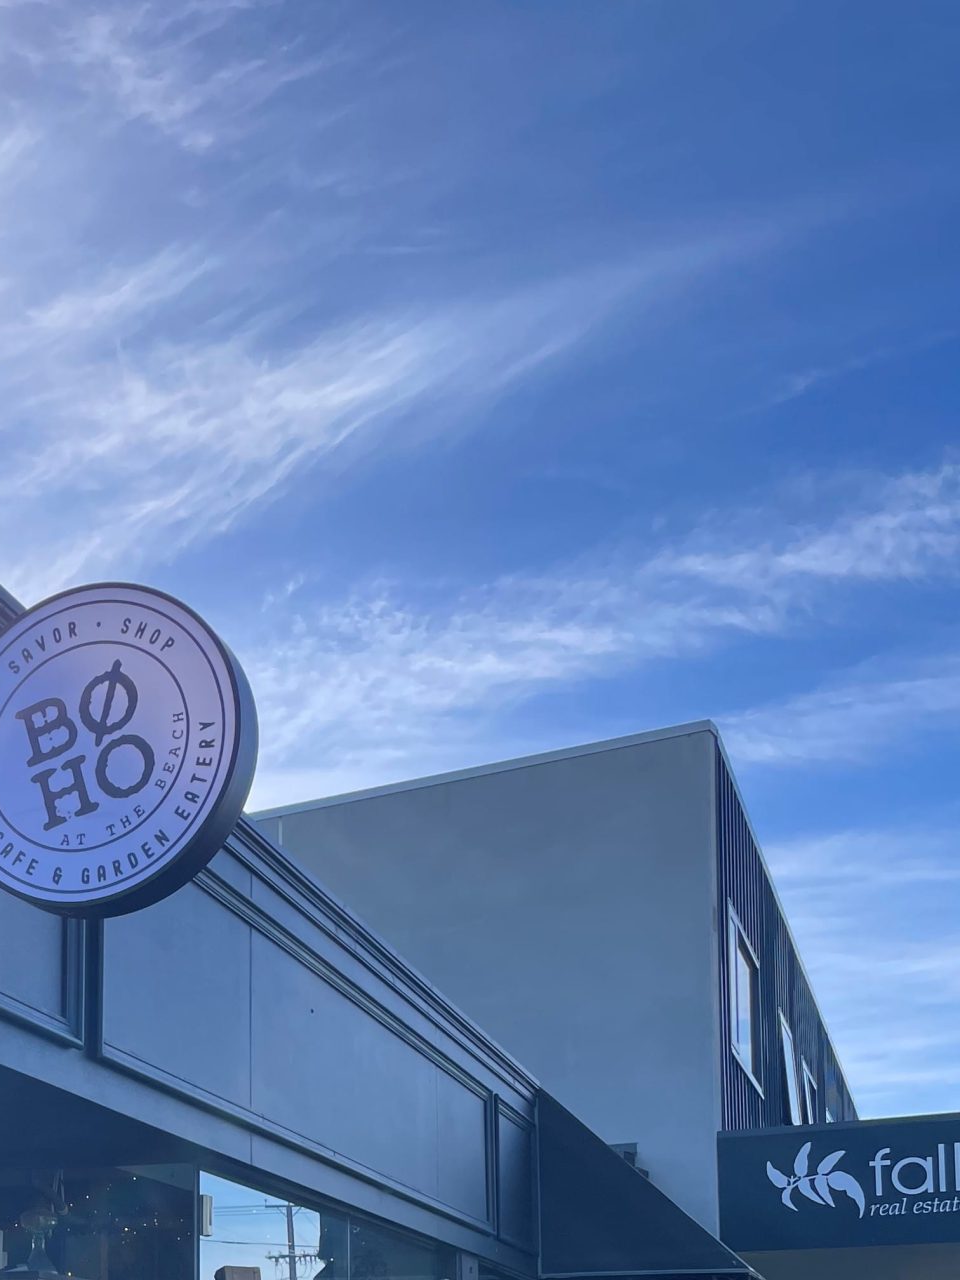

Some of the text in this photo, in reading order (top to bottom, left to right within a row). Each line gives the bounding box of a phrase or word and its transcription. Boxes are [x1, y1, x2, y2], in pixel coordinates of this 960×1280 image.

[8, 620, 78, 674] SAVOR
[121, 618, 175, 652] SHOP
[52, 866, 63, 885] &
[81, 829, 170, 884] GARDEN
[175, 721, 216, 821] EATERY
[60, 711, 185, 846] AT THE BEACH
[869, 1142, 960, 1196] fall
[870, 1196, 960, 1217] real estat
